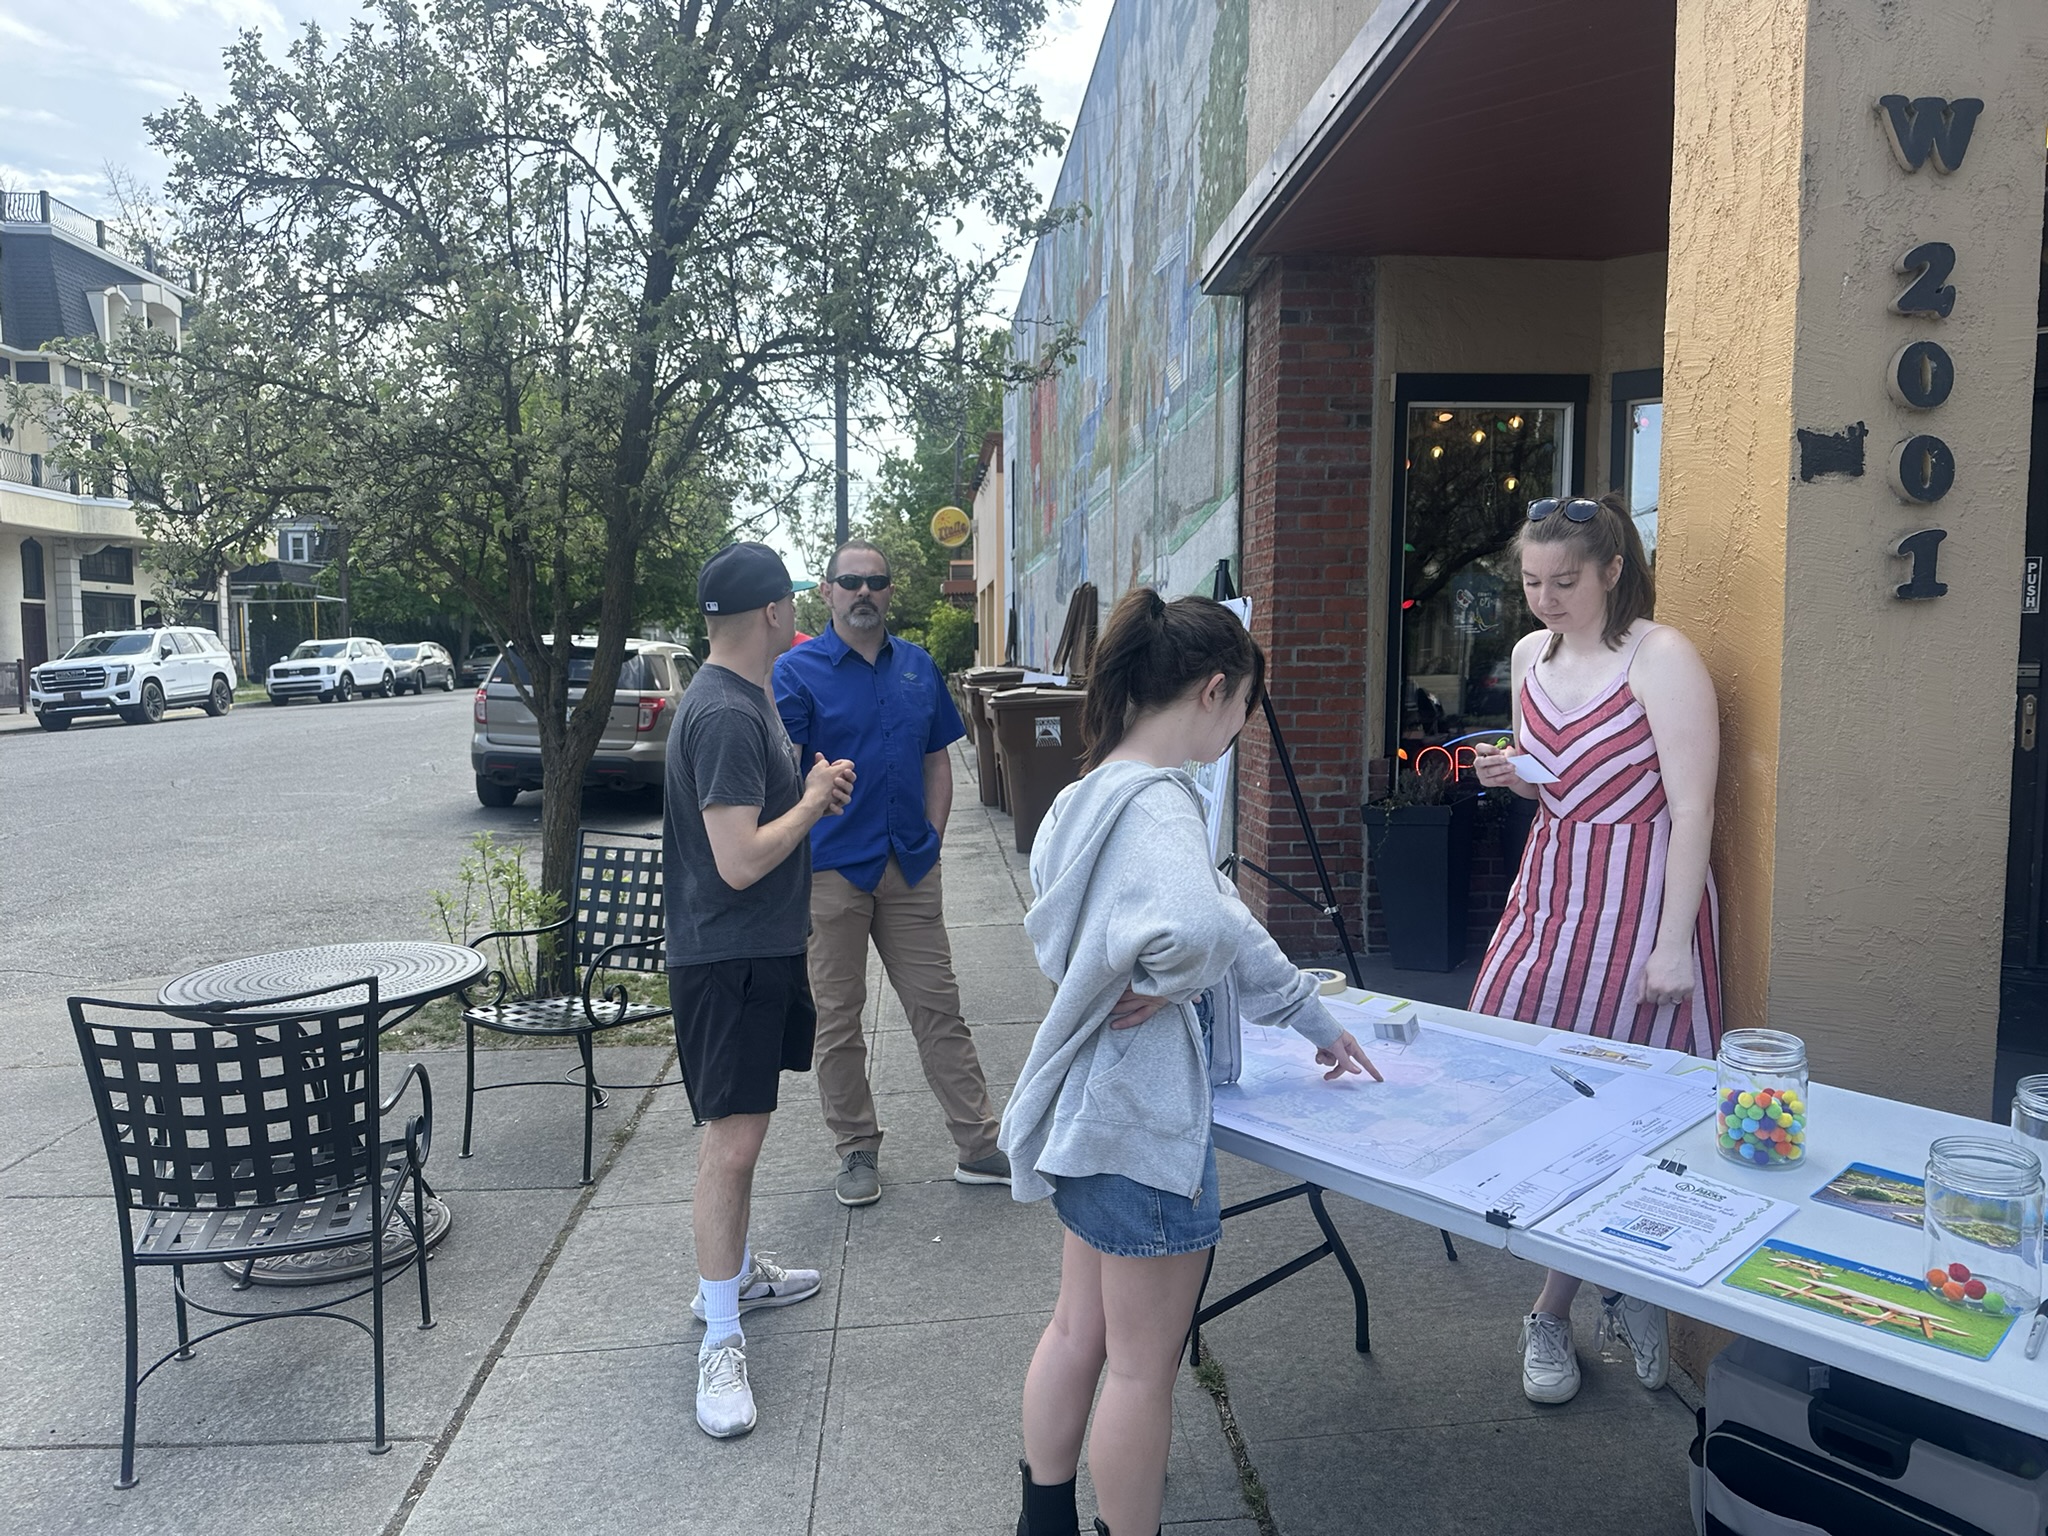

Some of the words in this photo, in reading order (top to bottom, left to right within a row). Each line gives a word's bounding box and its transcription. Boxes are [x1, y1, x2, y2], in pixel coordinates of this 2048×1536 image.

[1879, 95, 1985, 173] W
[1890, 241, 1956, 600] 2001
[2025, 562, 2038, 608] PUSH
[1415, 745, 1477, 783] OP
